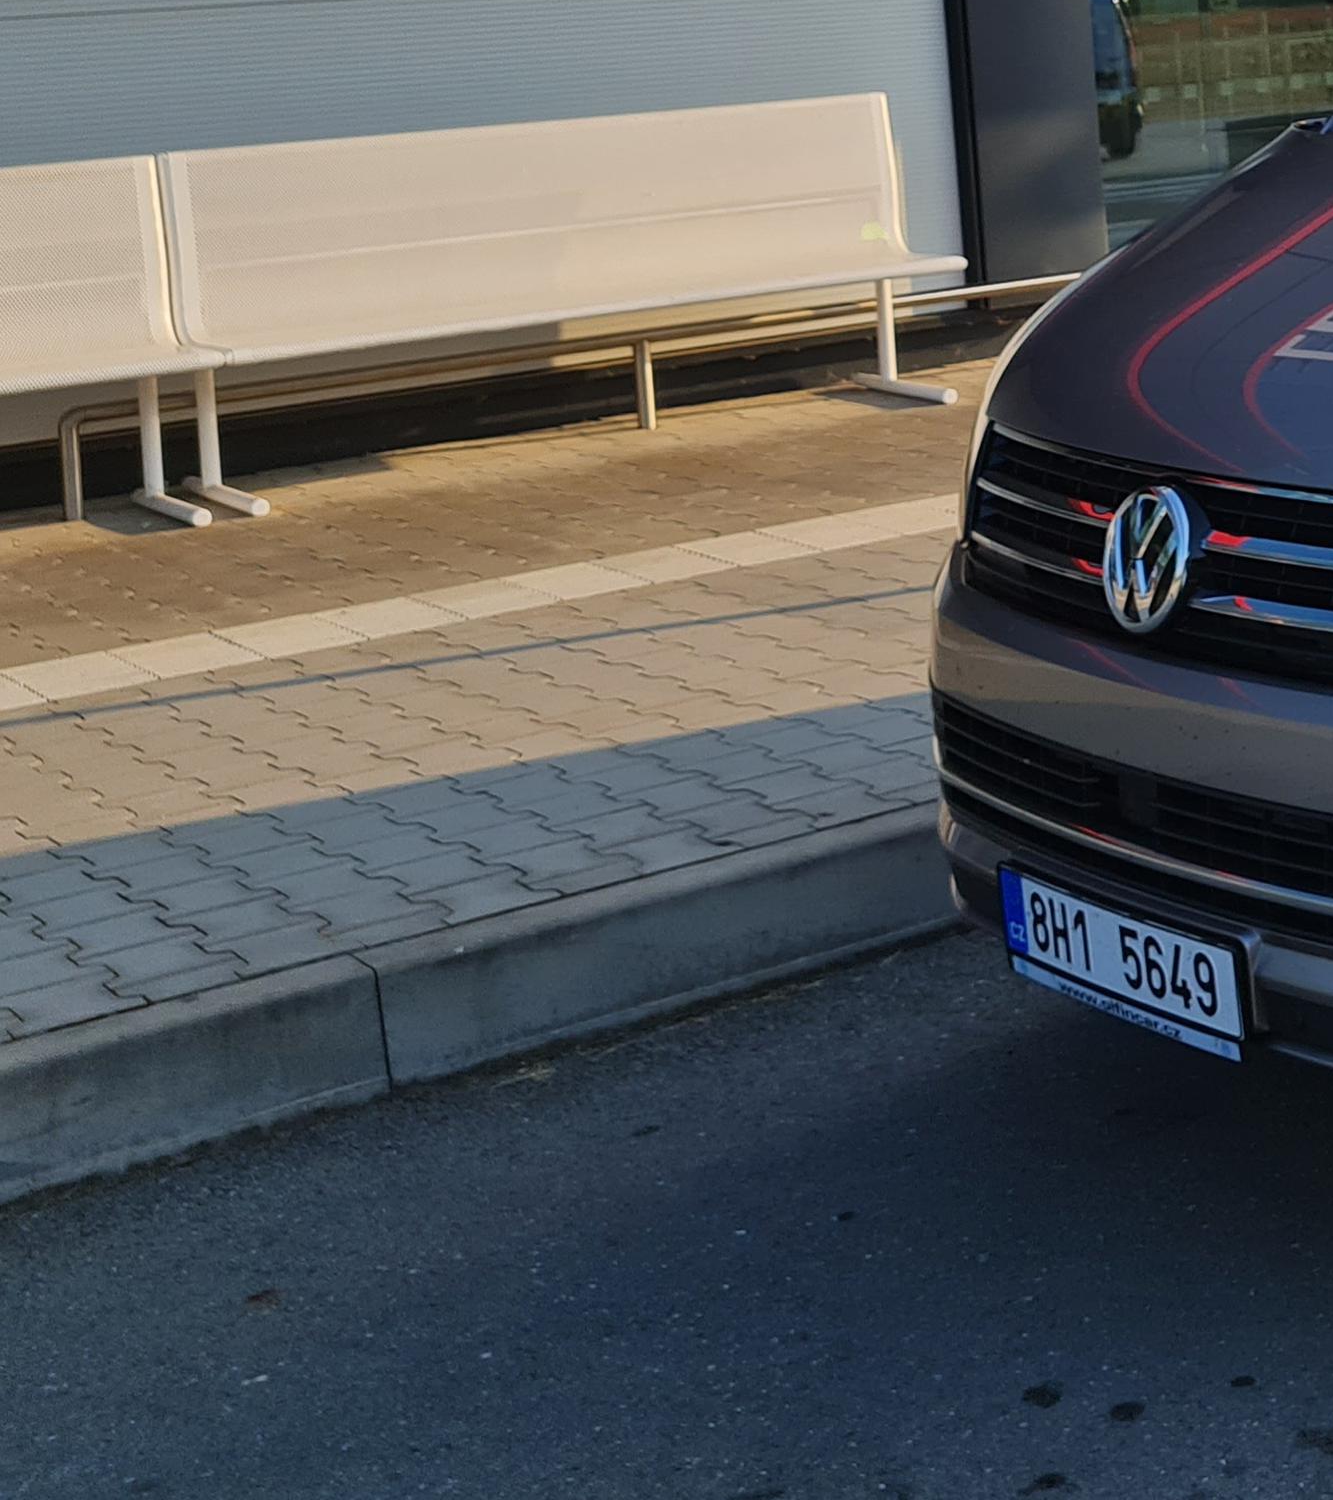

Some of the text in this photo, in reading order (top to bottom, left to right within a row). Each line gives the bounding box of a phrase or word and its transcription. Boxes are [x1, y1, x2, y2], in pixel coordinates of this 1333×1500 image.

[1008, 920, 1026, 943] CZ
[1029, 891, 1218, 1018] 8H1 5649
